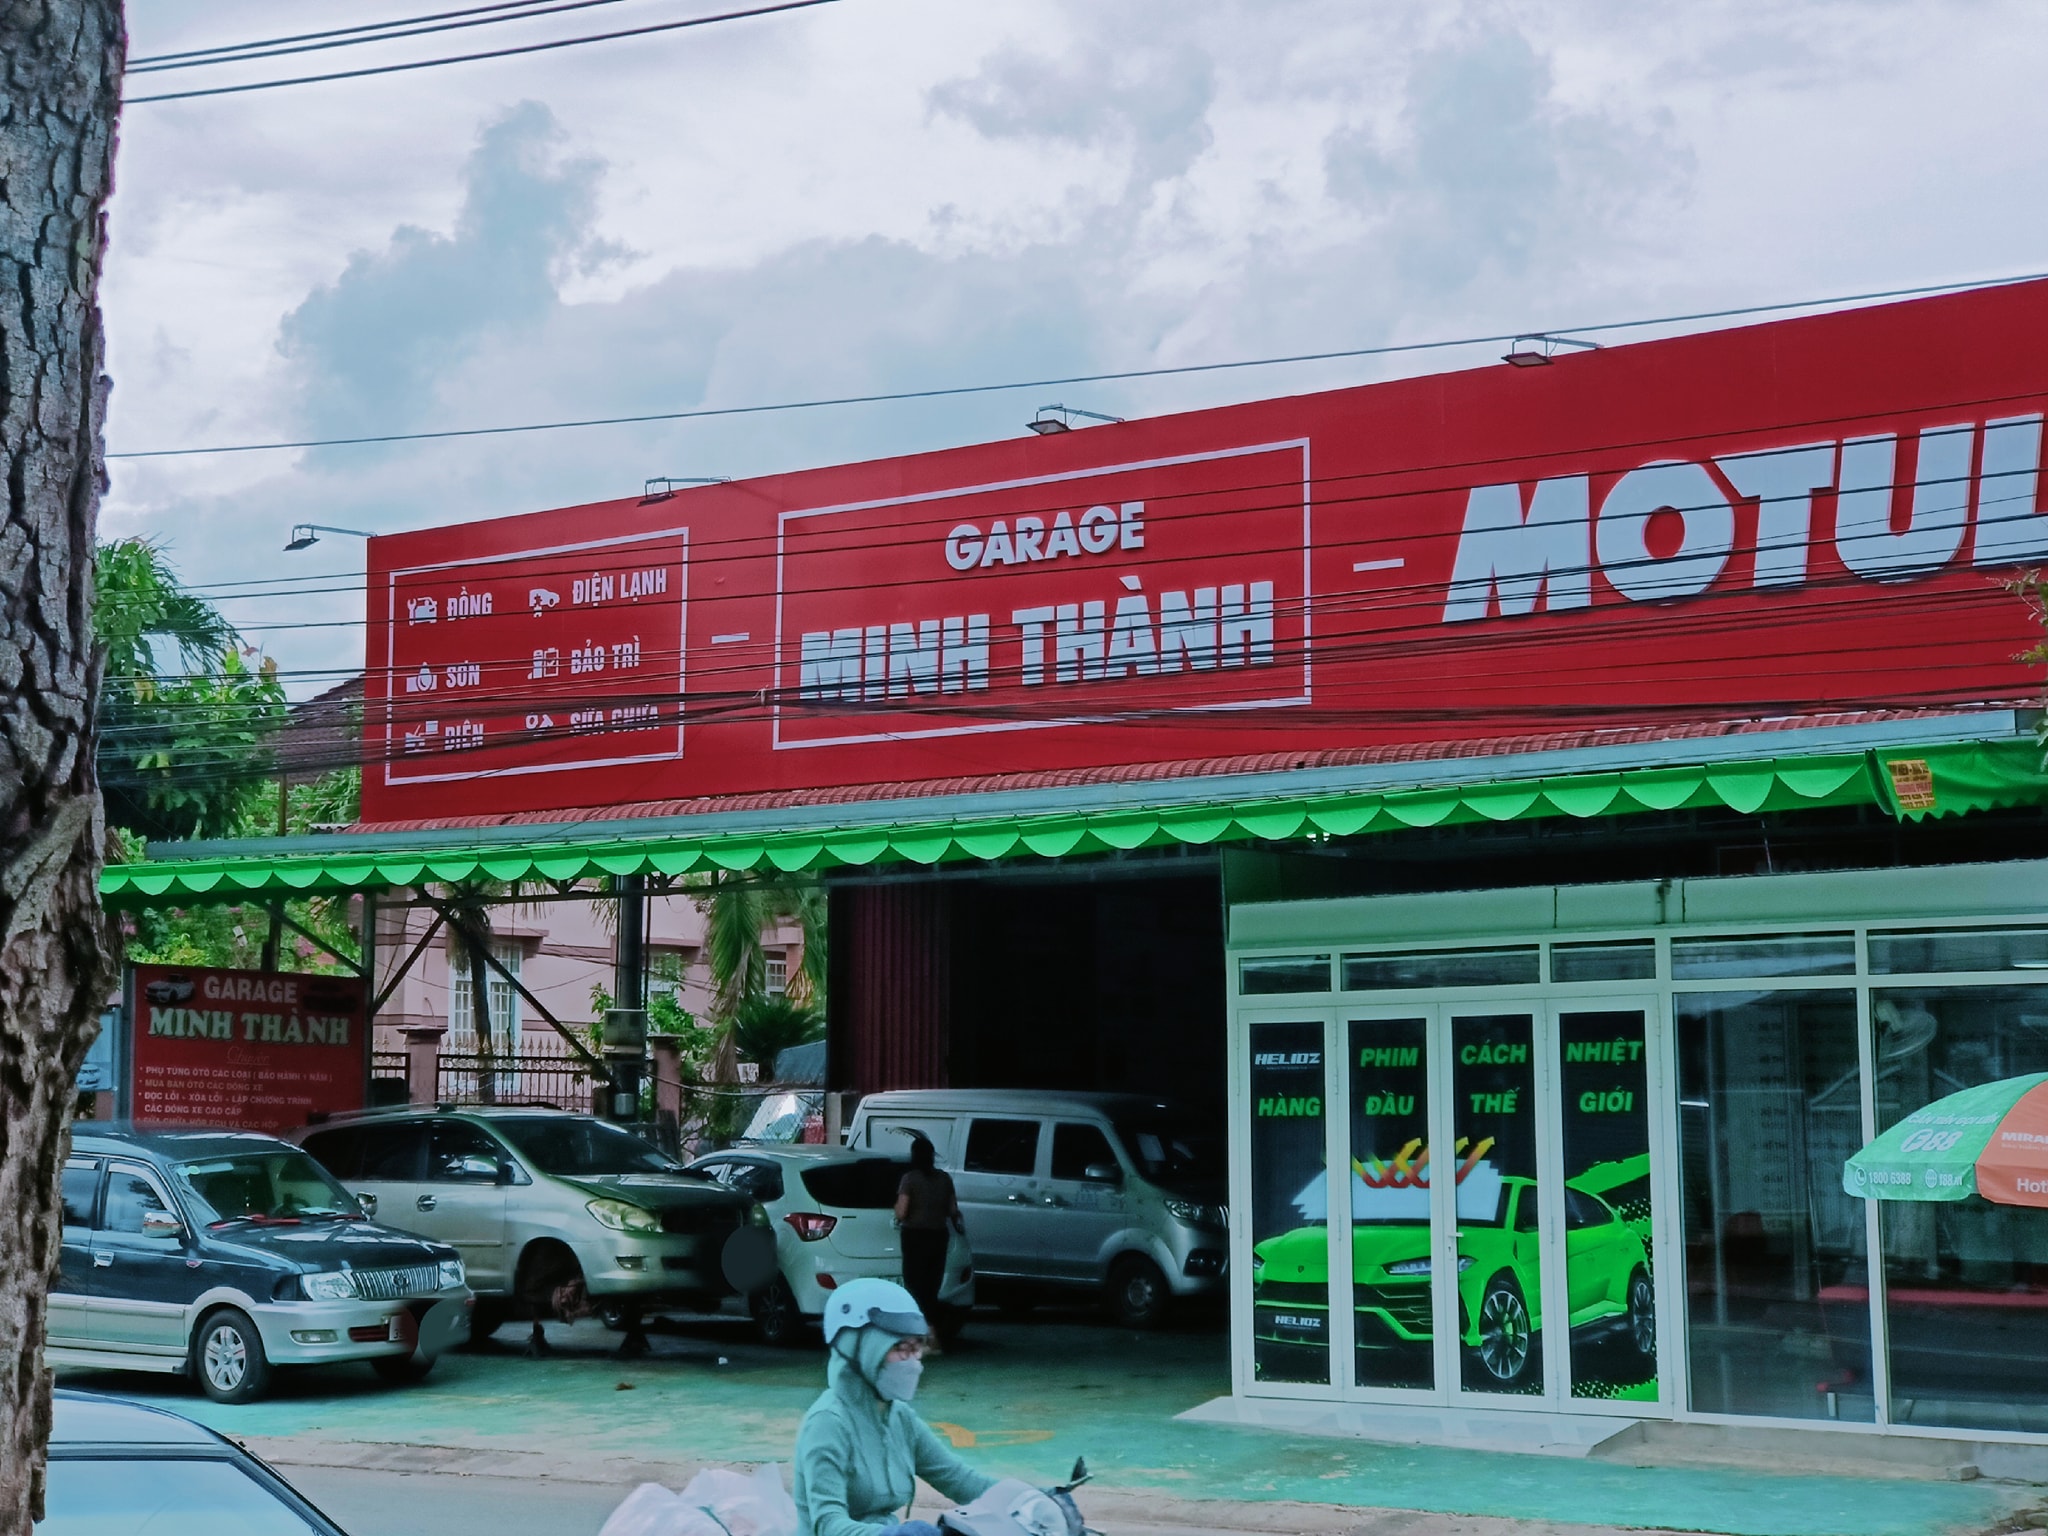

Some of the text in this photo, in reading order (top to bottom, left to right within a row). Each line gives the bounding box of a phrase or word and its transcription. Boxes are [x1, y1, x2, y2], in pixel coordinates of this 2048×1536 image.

[1442, 412, 2048, 623] MOTUL
[945, 501, 1145, 570] GARAGE
[572, 568, 667, 607] ĐIỆN LẠNH
[447, 587, 492, 622] ĐỒNG
[800, 575, 1274, 702] MINH THÀNH
[571, 636, 640, 674] BẢO TRÌ
[446, 660, 480, 688] SƠN
[204, 976, 298, 1003] GARAGE
[148, 1007, 350, 1045] MINH THÀNH
[1360, 1048, 1419, 1068] PHIM
[1461, 1039, 1527, 1065] CÁCH
[1566, 1037, 1643, 1065] NHIỆT
[192, 1106, 203, 1114] XE
[205, 1106, 223, 1114] CAO
[1259, 1086, 1633, 1117] HÀNG ĐẦU THẾ GIỚI
[1901, 1128, 1963, 1152] F88
[2001, 1132, 2048, 1145] MIRA
[1868, 1172, 1889, 1184] 1800
[1890, 1172, 1912, 1185] 6388
